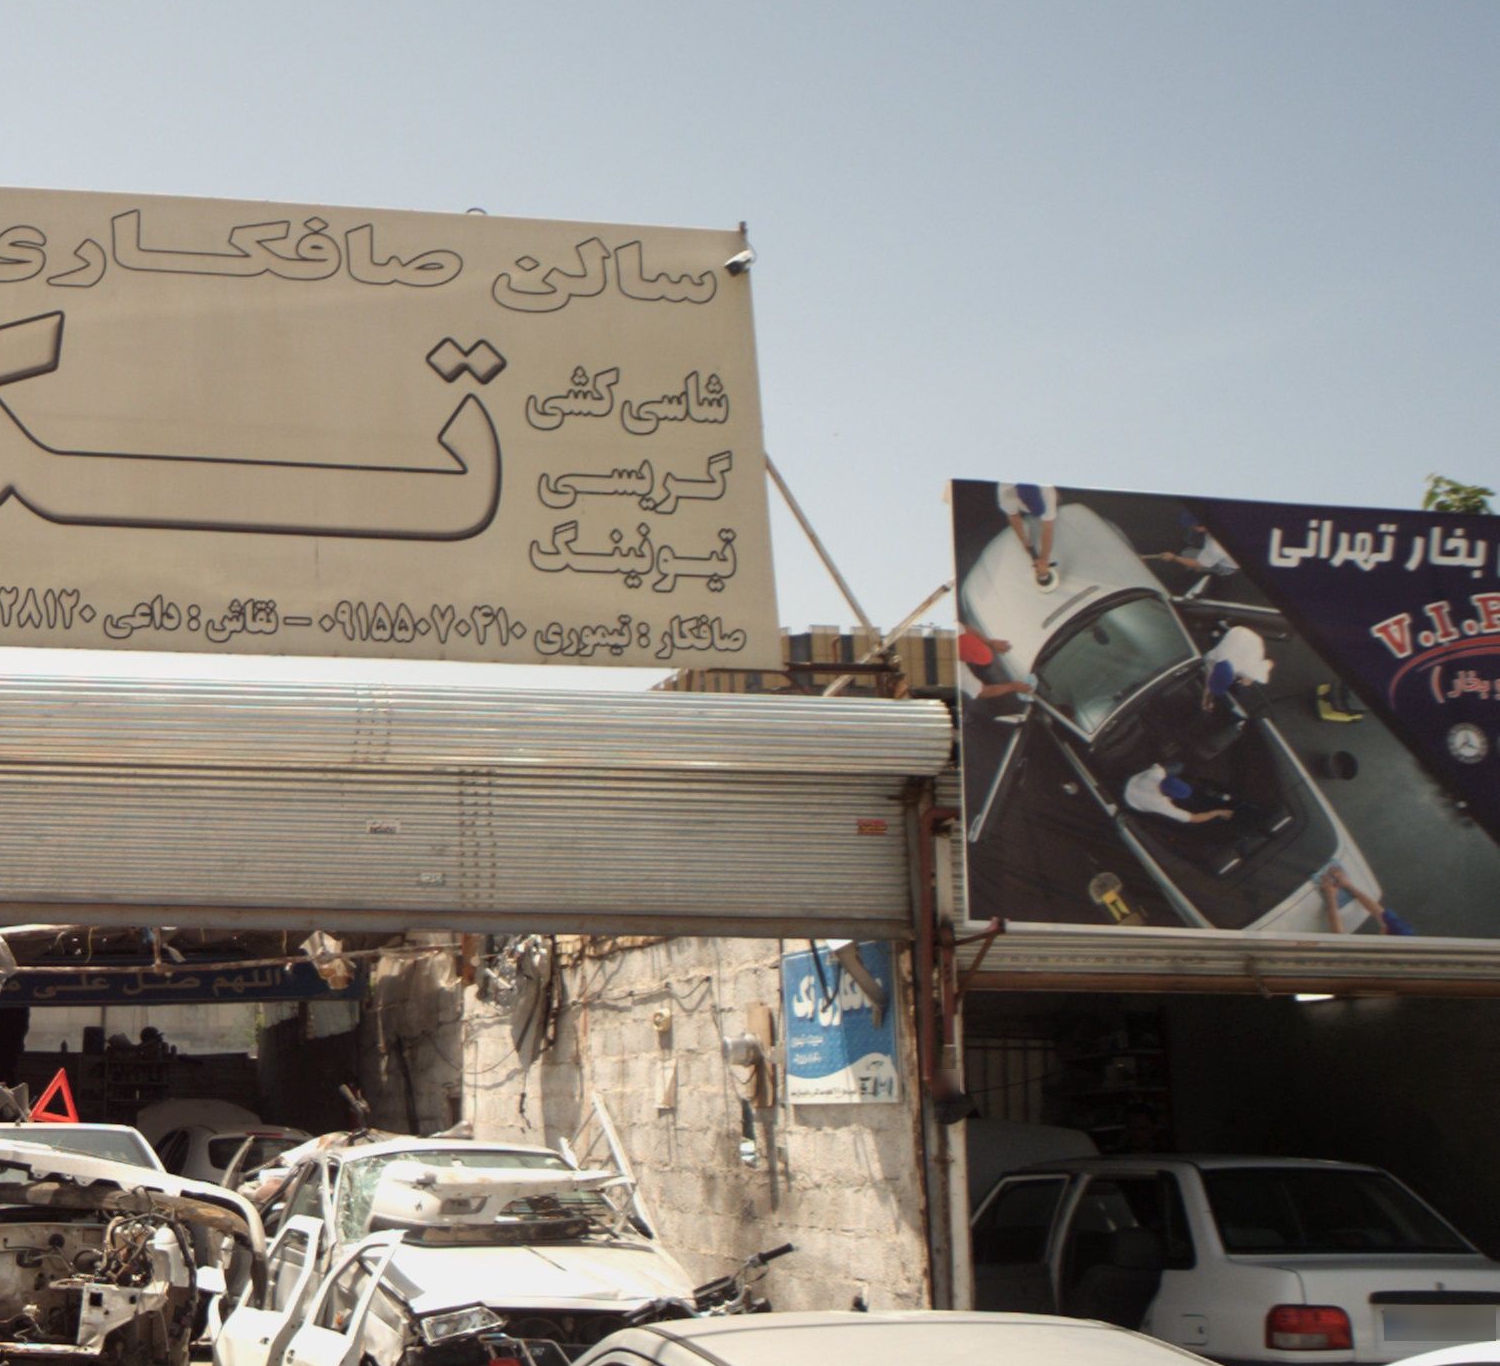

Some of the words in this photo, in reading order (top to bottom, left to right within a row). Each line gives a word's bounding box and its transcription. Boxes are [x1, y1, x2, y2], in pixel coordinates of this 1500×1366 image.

[492, 236, 718, 313] سالن
[526, 366, 620, 430] کشی
[621, 370, 729, 435] شاسی
[538, 450, 732, 514] گریسی
[530, 520, 737, 593] تیونینگ
[1268, 519, 1398, 572] تهرانی
[1405, 526, 1487, 579] بخار
[104, 594, 181, 639] داعی
[319, 600, 527, 647] ۰۹۱۵۵۰۷۰۴۱۰
[533, 614, 632, 657] تیموری
